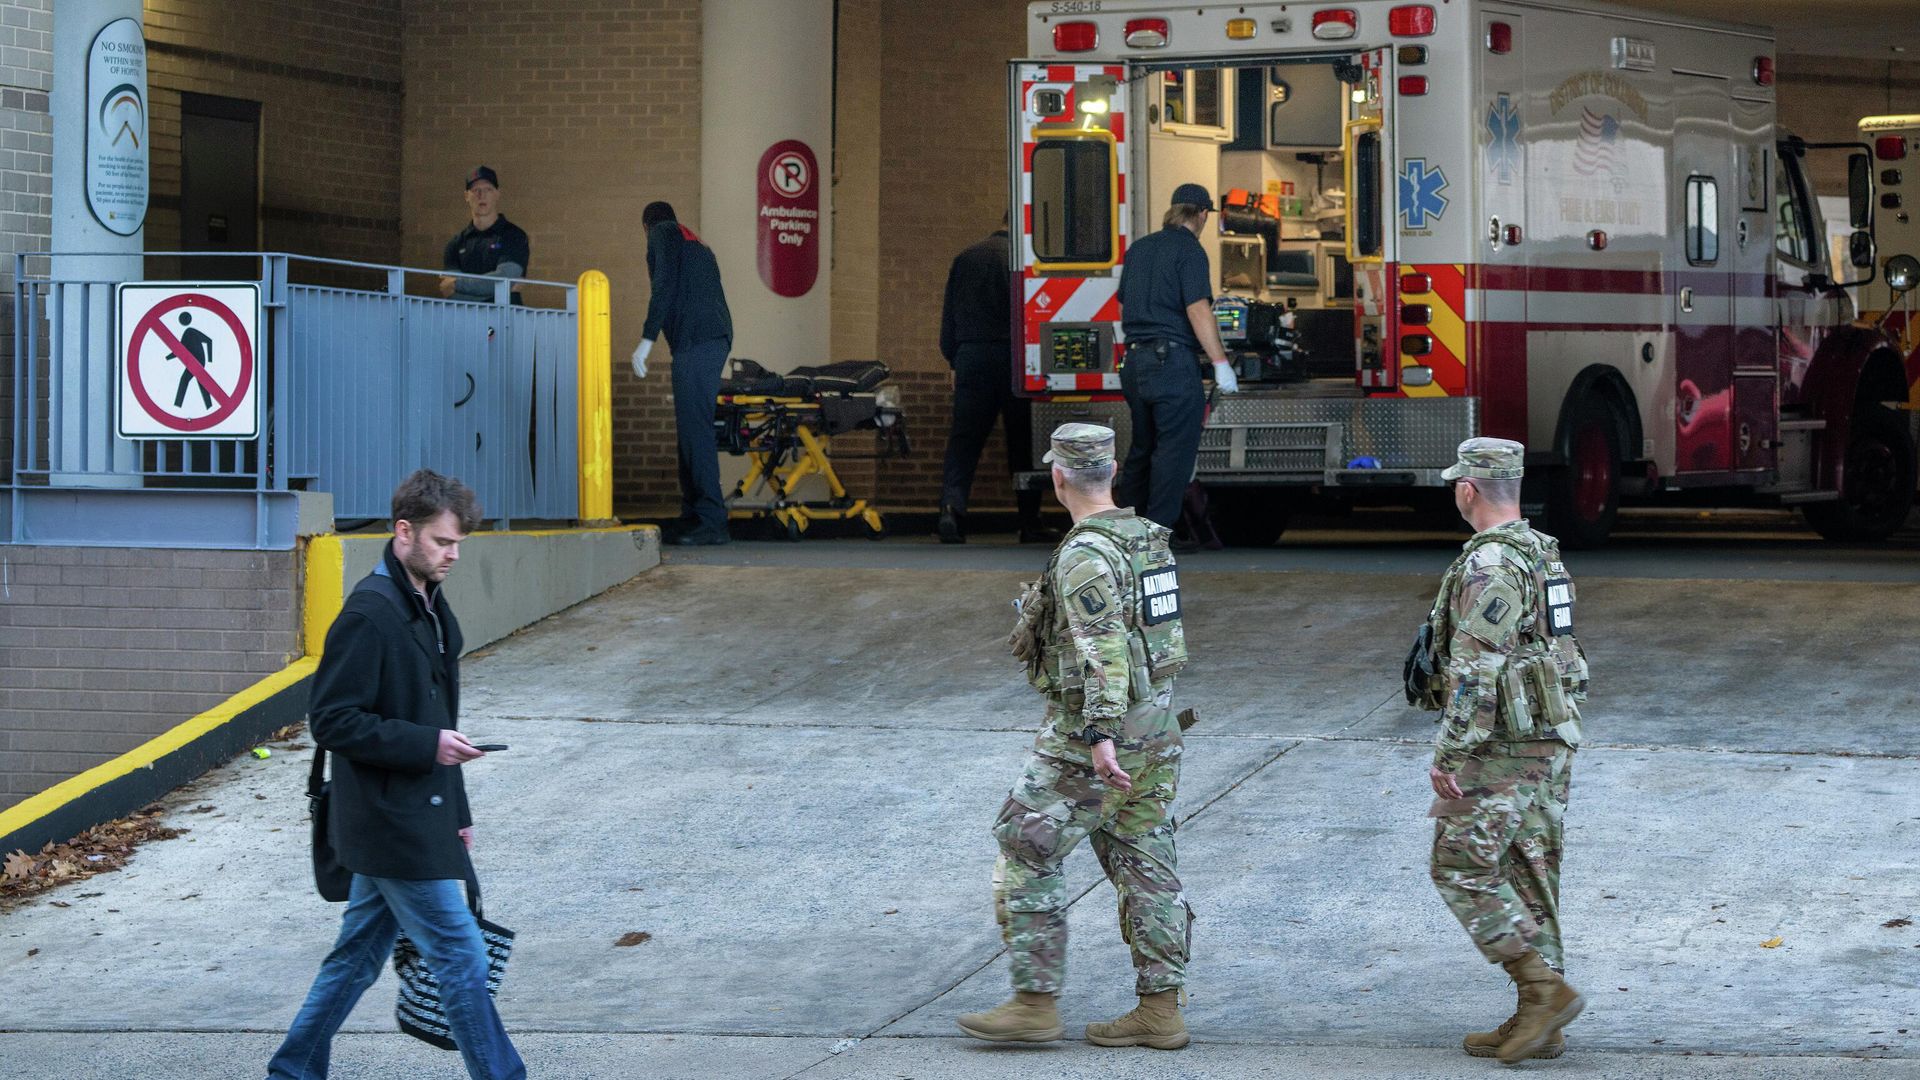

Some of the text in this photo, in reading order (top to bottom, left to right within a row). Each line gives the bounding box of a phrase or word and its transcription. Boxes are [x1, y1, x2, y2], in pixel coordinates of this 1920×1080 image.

[101, 41, 116, 52] NO
[103, 56, 129, 65] WITHIN
[110, 66, 120, 74] OF
[760, 205, 818, 219] Ambulance
[770, 218, 811, 234] Parking
[778, 232, 804, 247] Only
[1143, 570, 1179, 597] NATIONAL
[1150, 593, 1178, 618] GUARD
